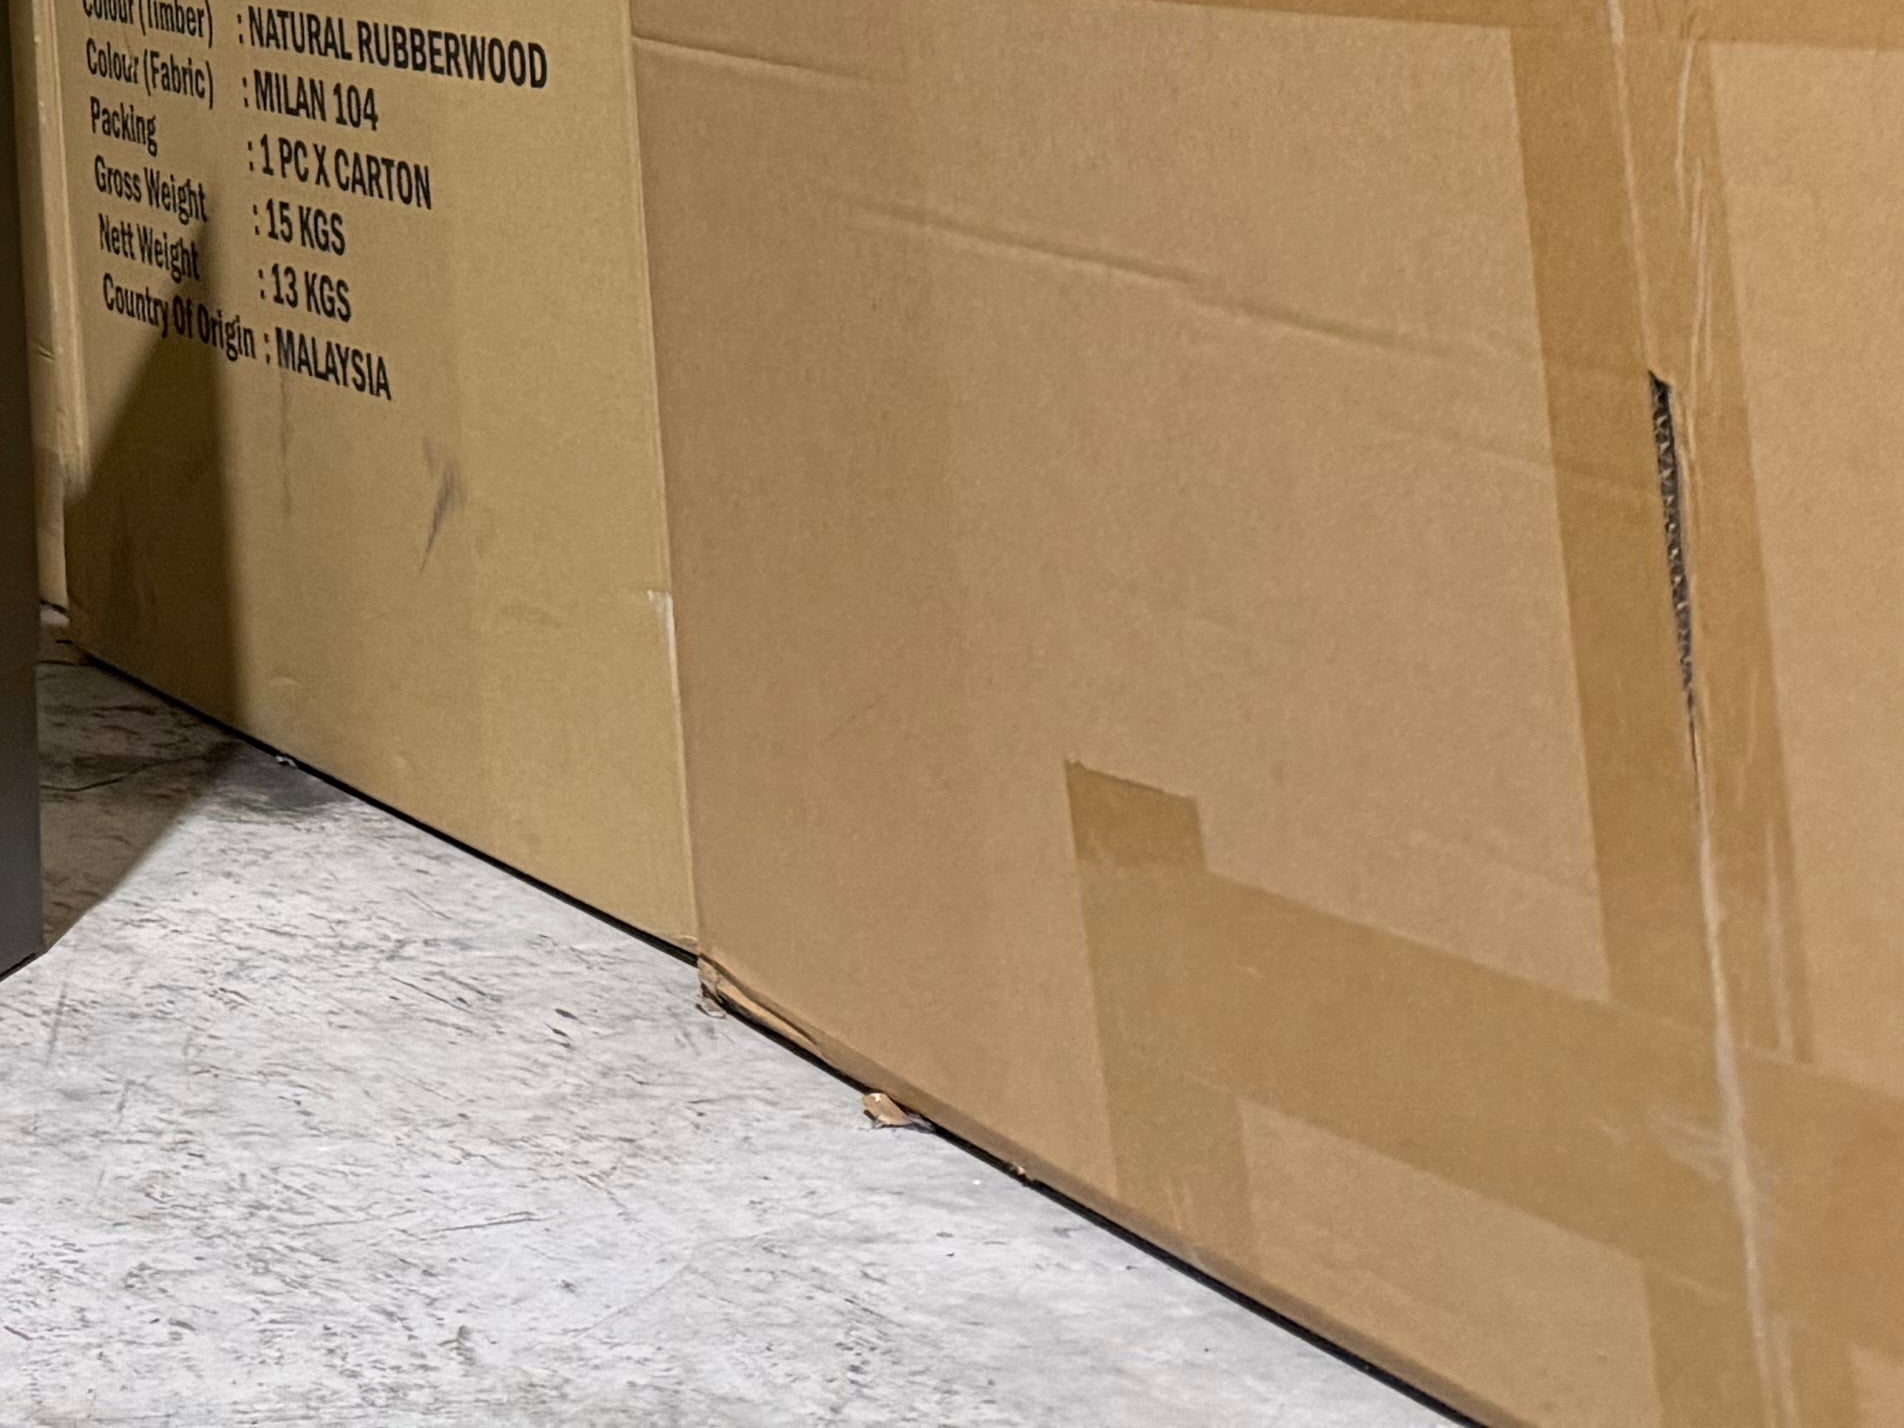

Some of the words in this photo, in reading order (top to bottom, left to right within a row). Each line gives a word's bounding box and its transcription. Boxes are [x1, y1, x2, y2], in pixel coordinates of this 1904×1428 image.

[249, 6, 353, 61] NATURAL
[356, 20, 547, 89] RUBBERWOOD
[98, 213, 135, 260] Nett
[137, 223, 200, 283] Weight
[271, 263, 299, 309] 13
[304, 270, 352, 323] KGS
[103, 273, 169, 338] Country
[173, 296, 192, 338] Of
[197, 303, 256, 361] Origin
[274, 326, 392, 401] MALAYSIA
